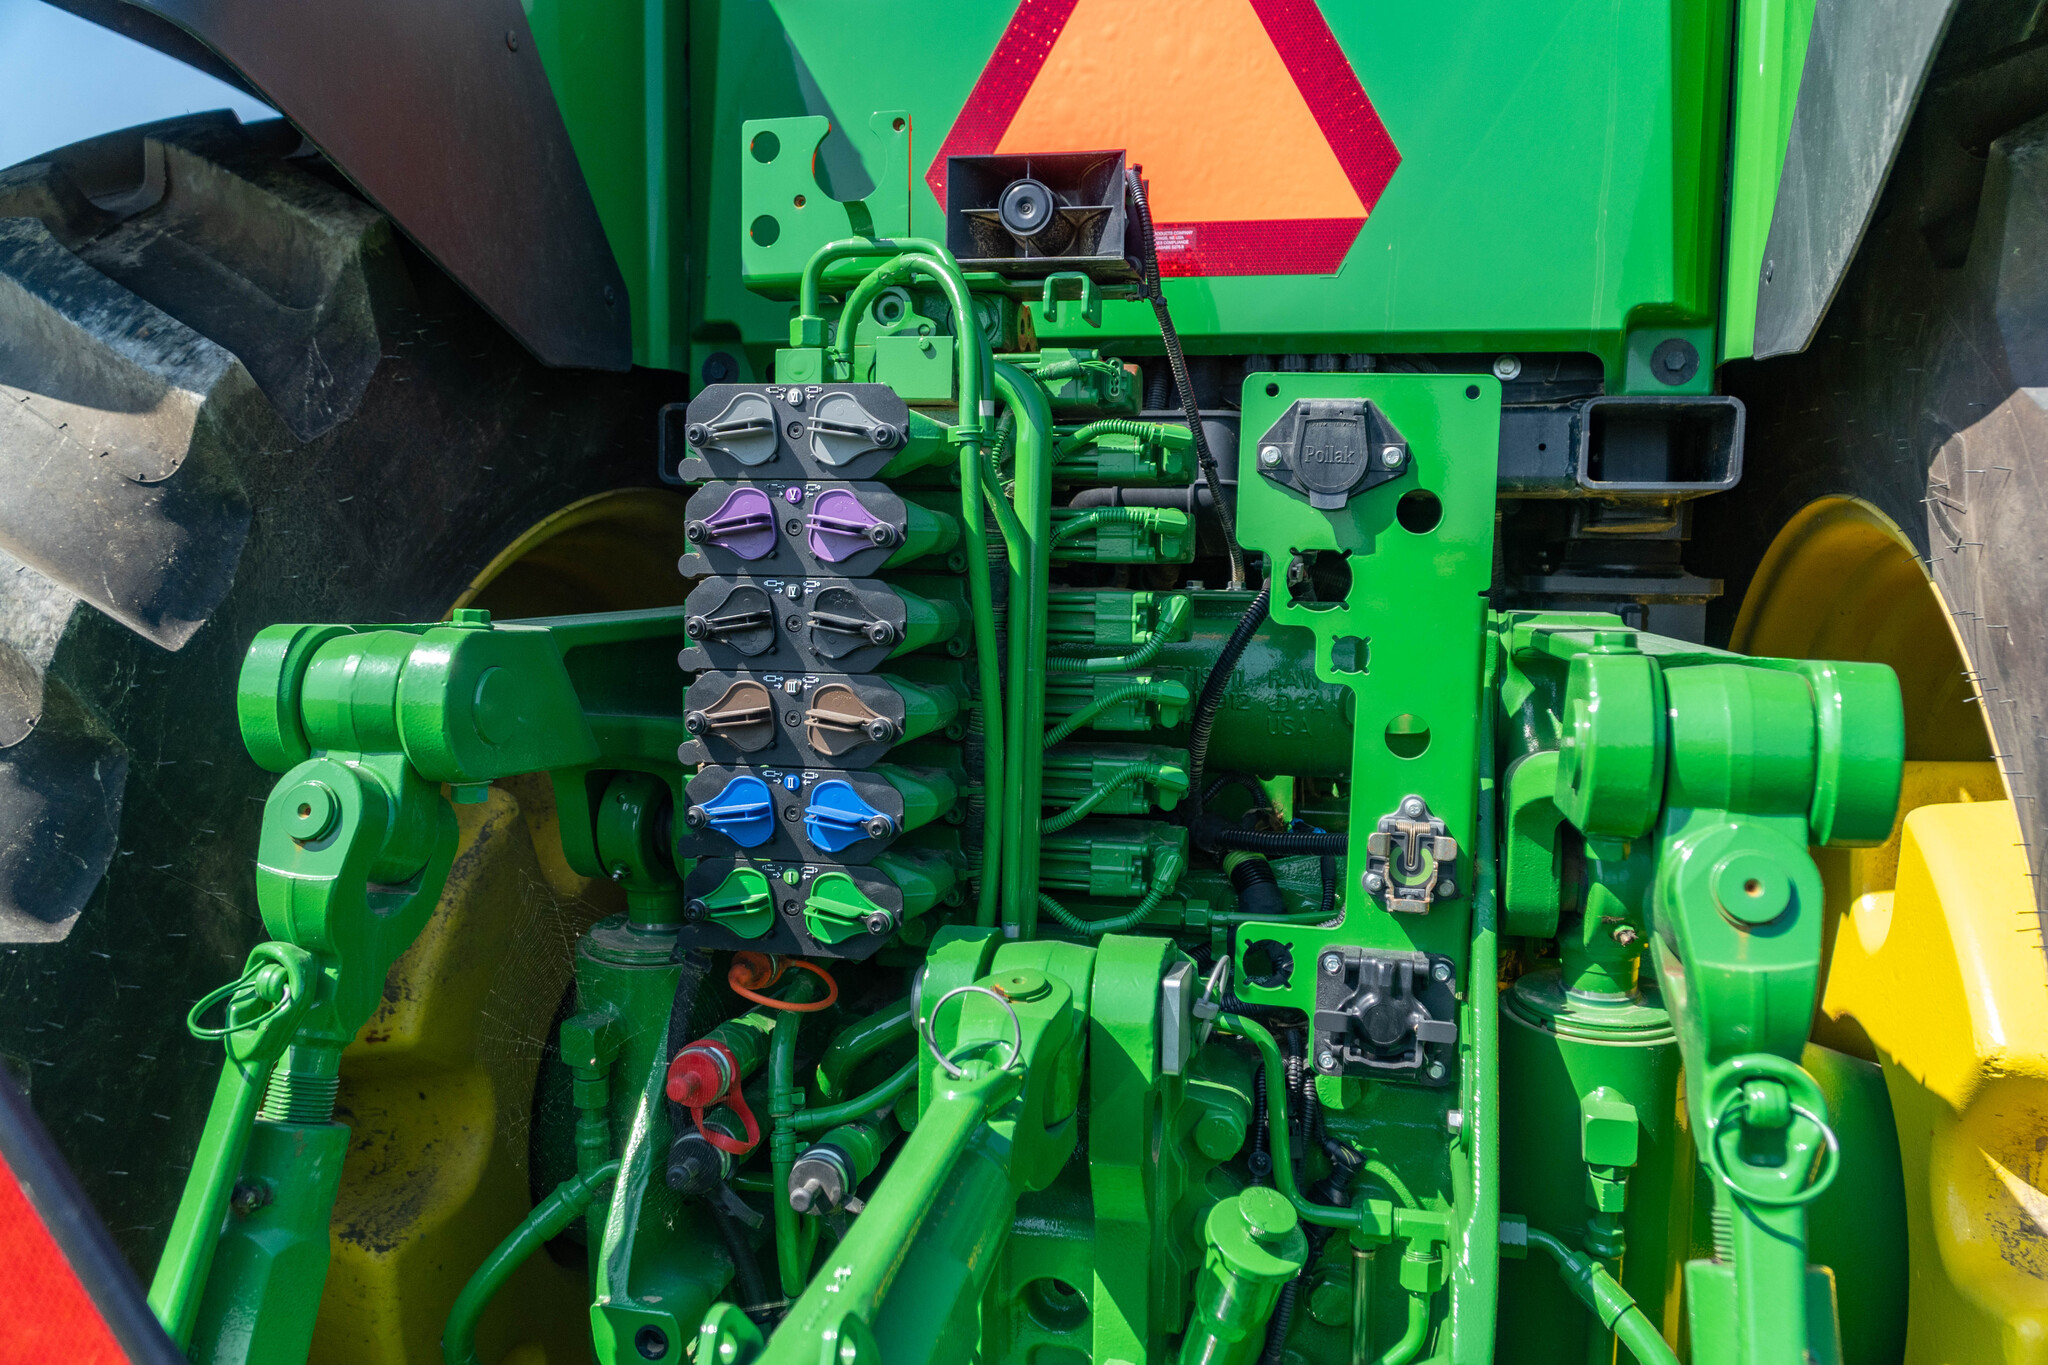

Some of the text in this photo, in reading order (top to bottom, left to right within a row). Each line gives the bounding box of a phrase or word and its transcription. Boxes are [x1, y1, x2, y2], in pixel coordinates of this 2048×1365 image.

[790, 391, 799, 403] VI
[1304, 445, 1355, 465] Pollak
[789, 489, 797, 501] V
[788, 586, 797, 598] IV
[787, 681, 796, 693] III
[1266, 715, 1313, 737] USA
[787, 777, 794, 789] II
